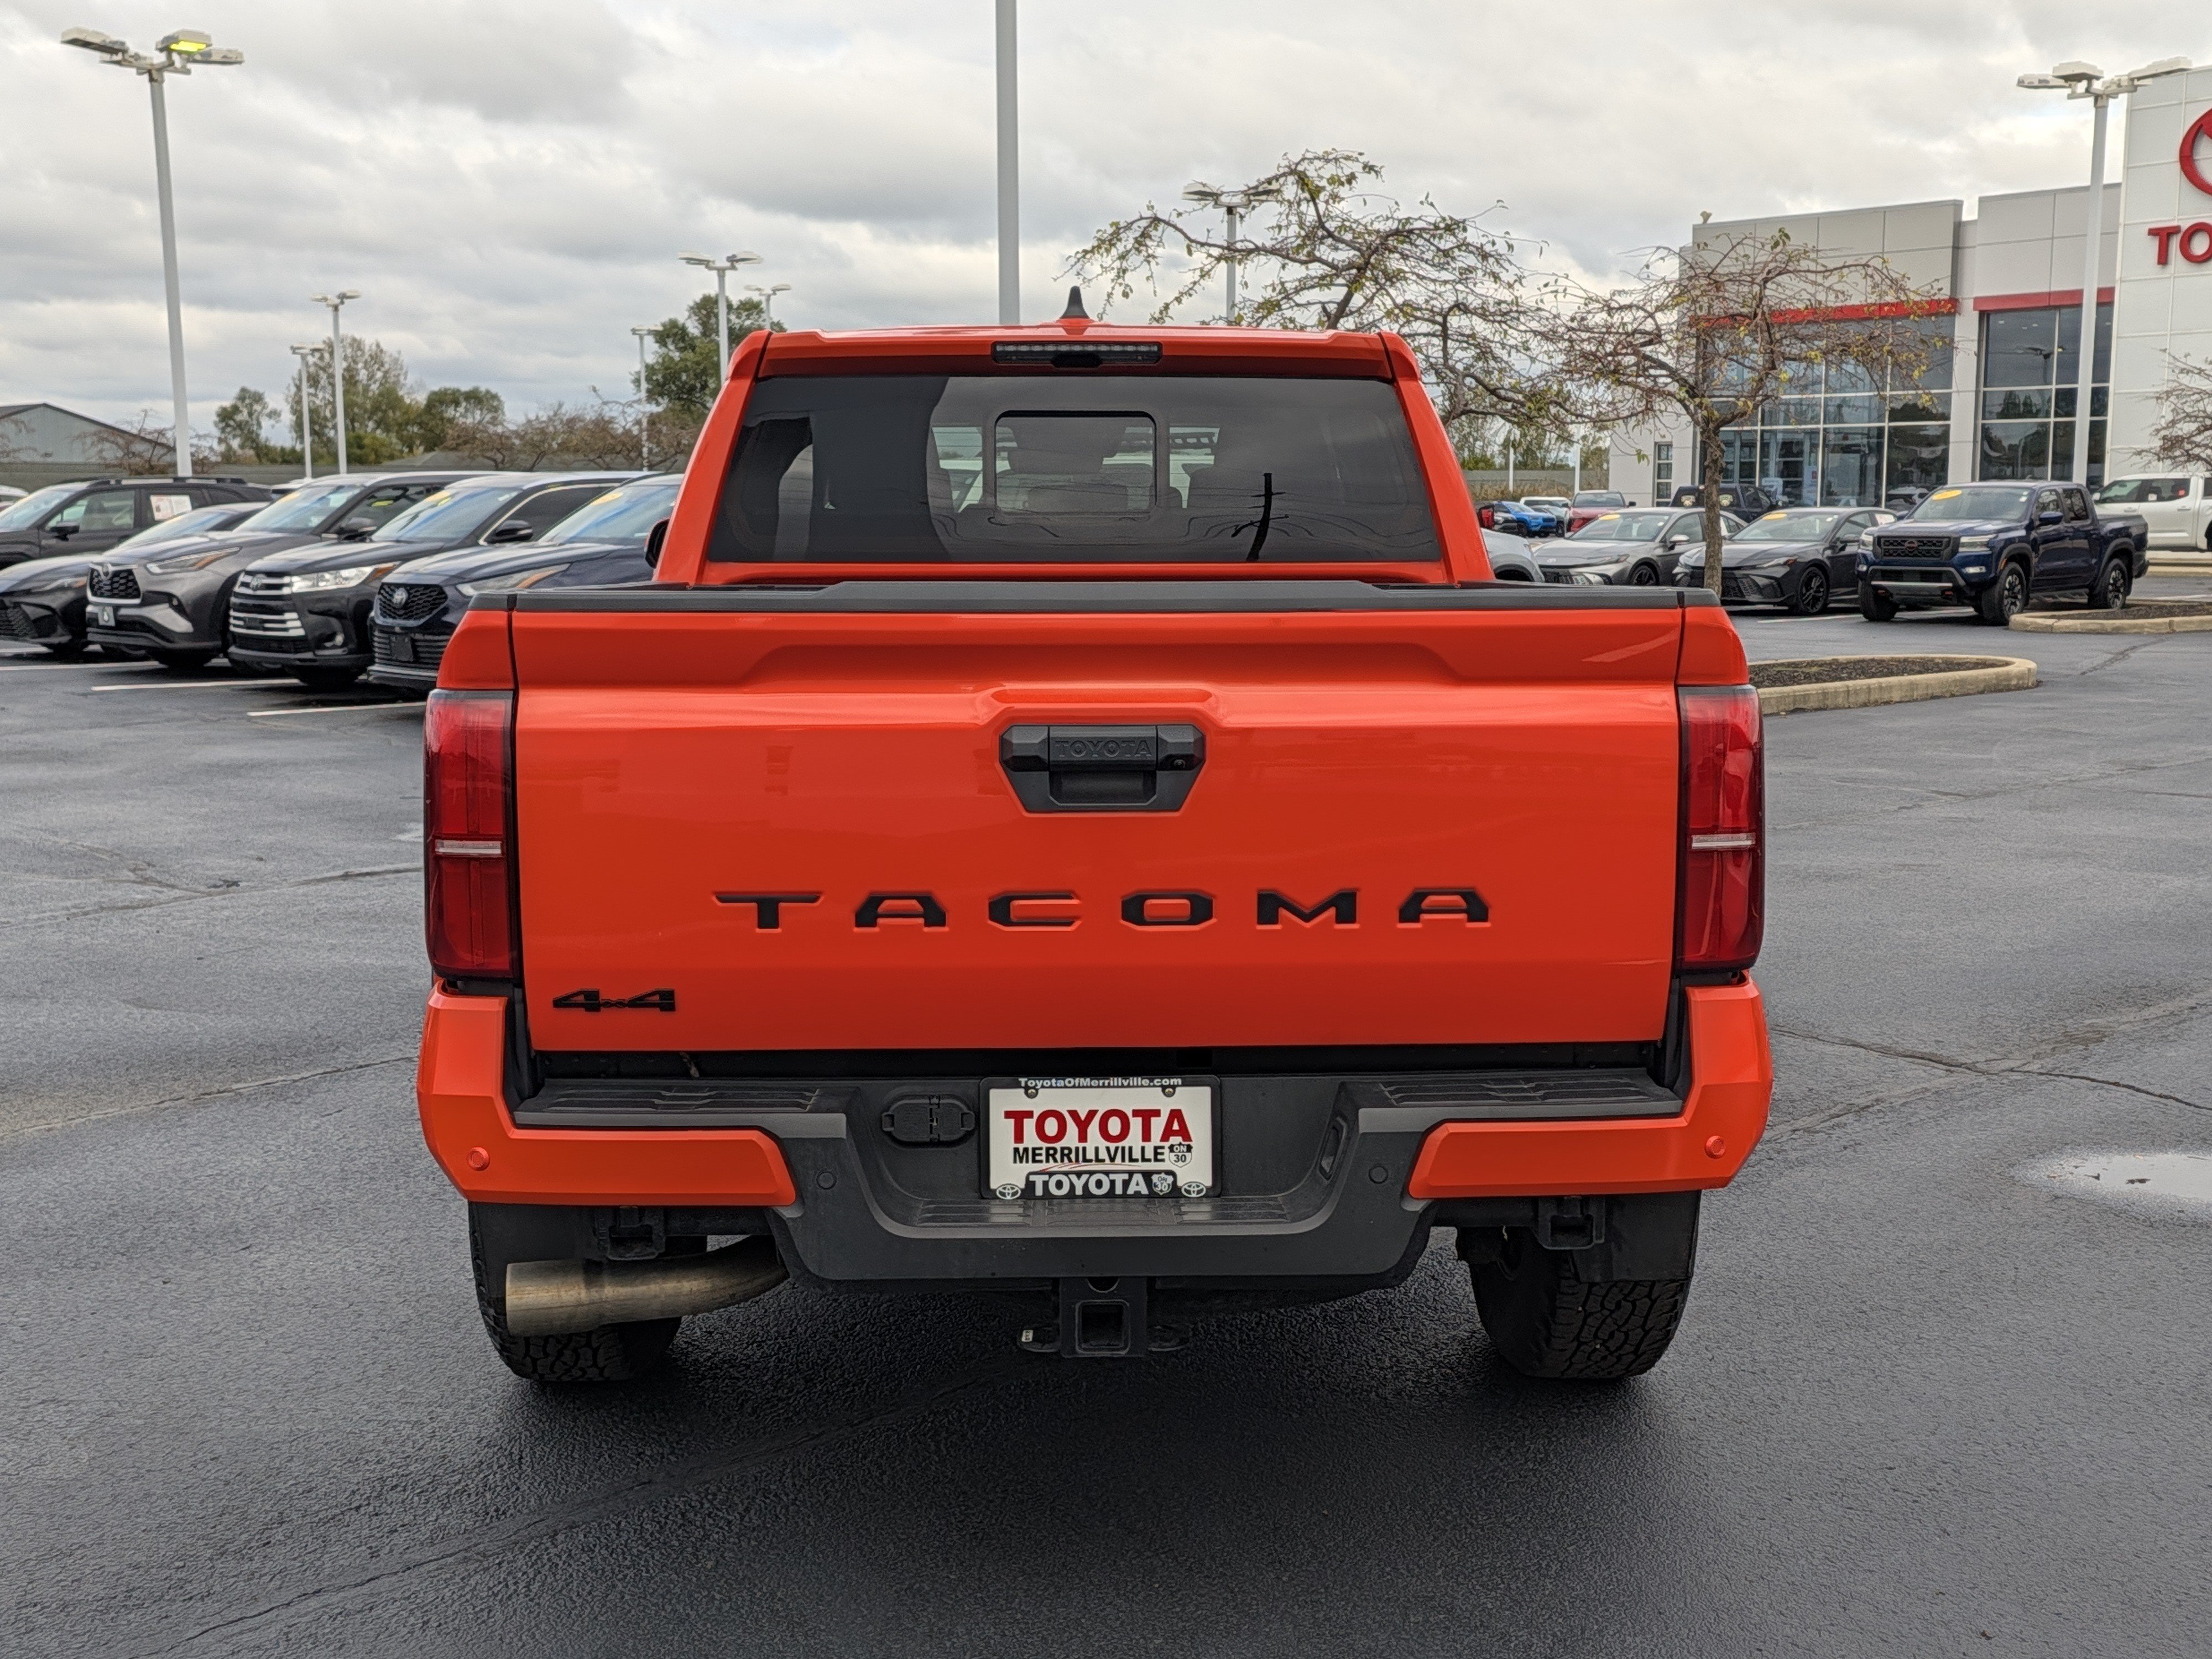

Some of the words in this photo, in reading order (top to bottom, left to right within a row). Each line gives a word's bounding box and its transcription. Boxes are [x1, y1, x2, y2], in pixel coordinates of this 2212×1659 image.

[1055, 740, 1152, 758] TOYOTA
[712, 888, 1491, 931] TACOMA
[1018, 1077, 1182, 1089] ToyotaOfMerrillville.com
[1004, 1109, 1193, 1144] TOYOTA
[1013, 1145, 1165, 1164] MERRILLVILLE
[1173, 1154, 1187, 1162] 30
[1029, 1173, 1149, 1196] TOYOTA
